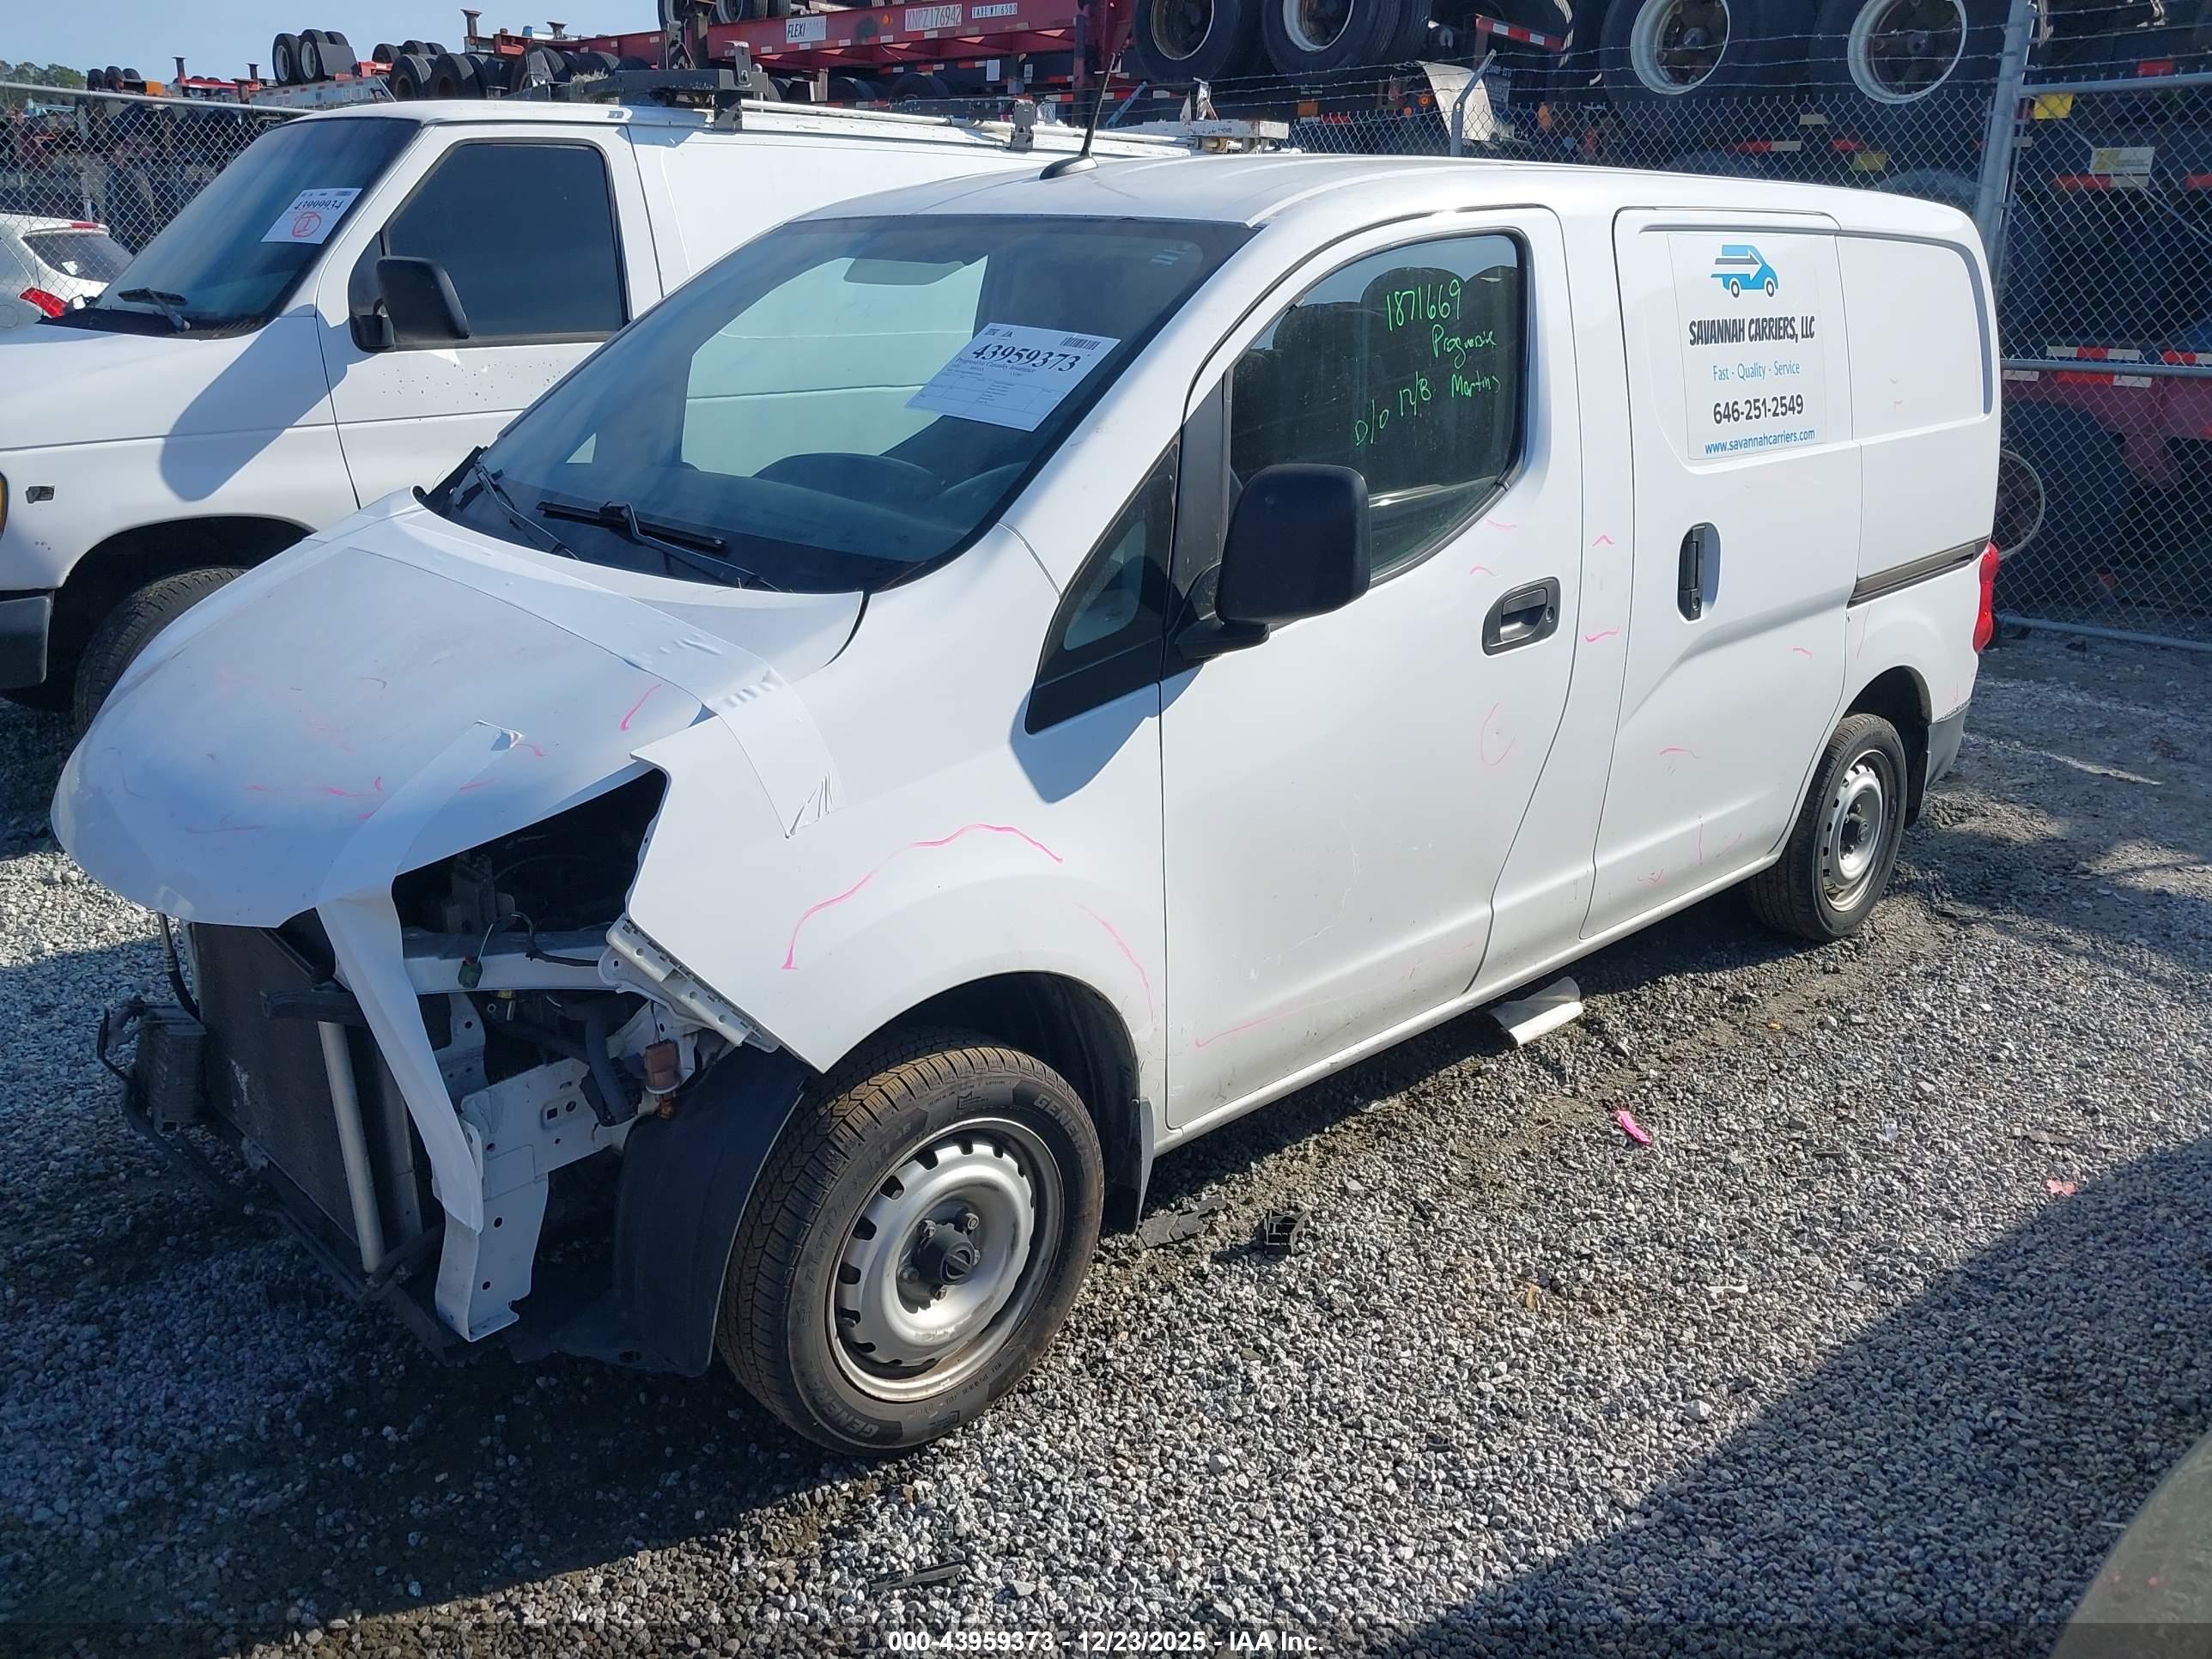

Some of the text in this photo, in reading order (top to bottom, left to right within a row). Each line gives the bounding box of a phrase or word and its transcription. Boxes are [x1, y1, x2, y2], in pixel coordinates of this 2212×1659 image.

[1386, 278, 1461, 331] 1871669
[1688, 315, 1815, 346] SAVANNAH CARRIERS, LLC
[972, 343, 1082, 372] 43959373
[1712, 365, 1729, 381] Fast
[1737, 362, 1766, 381] Quality
[1774, 359, 1801, 376] Service
[1713, 393, 1804, 425] 646-251-2549
[1705, 428, 1815, 455] www.savannahcarriers.com
